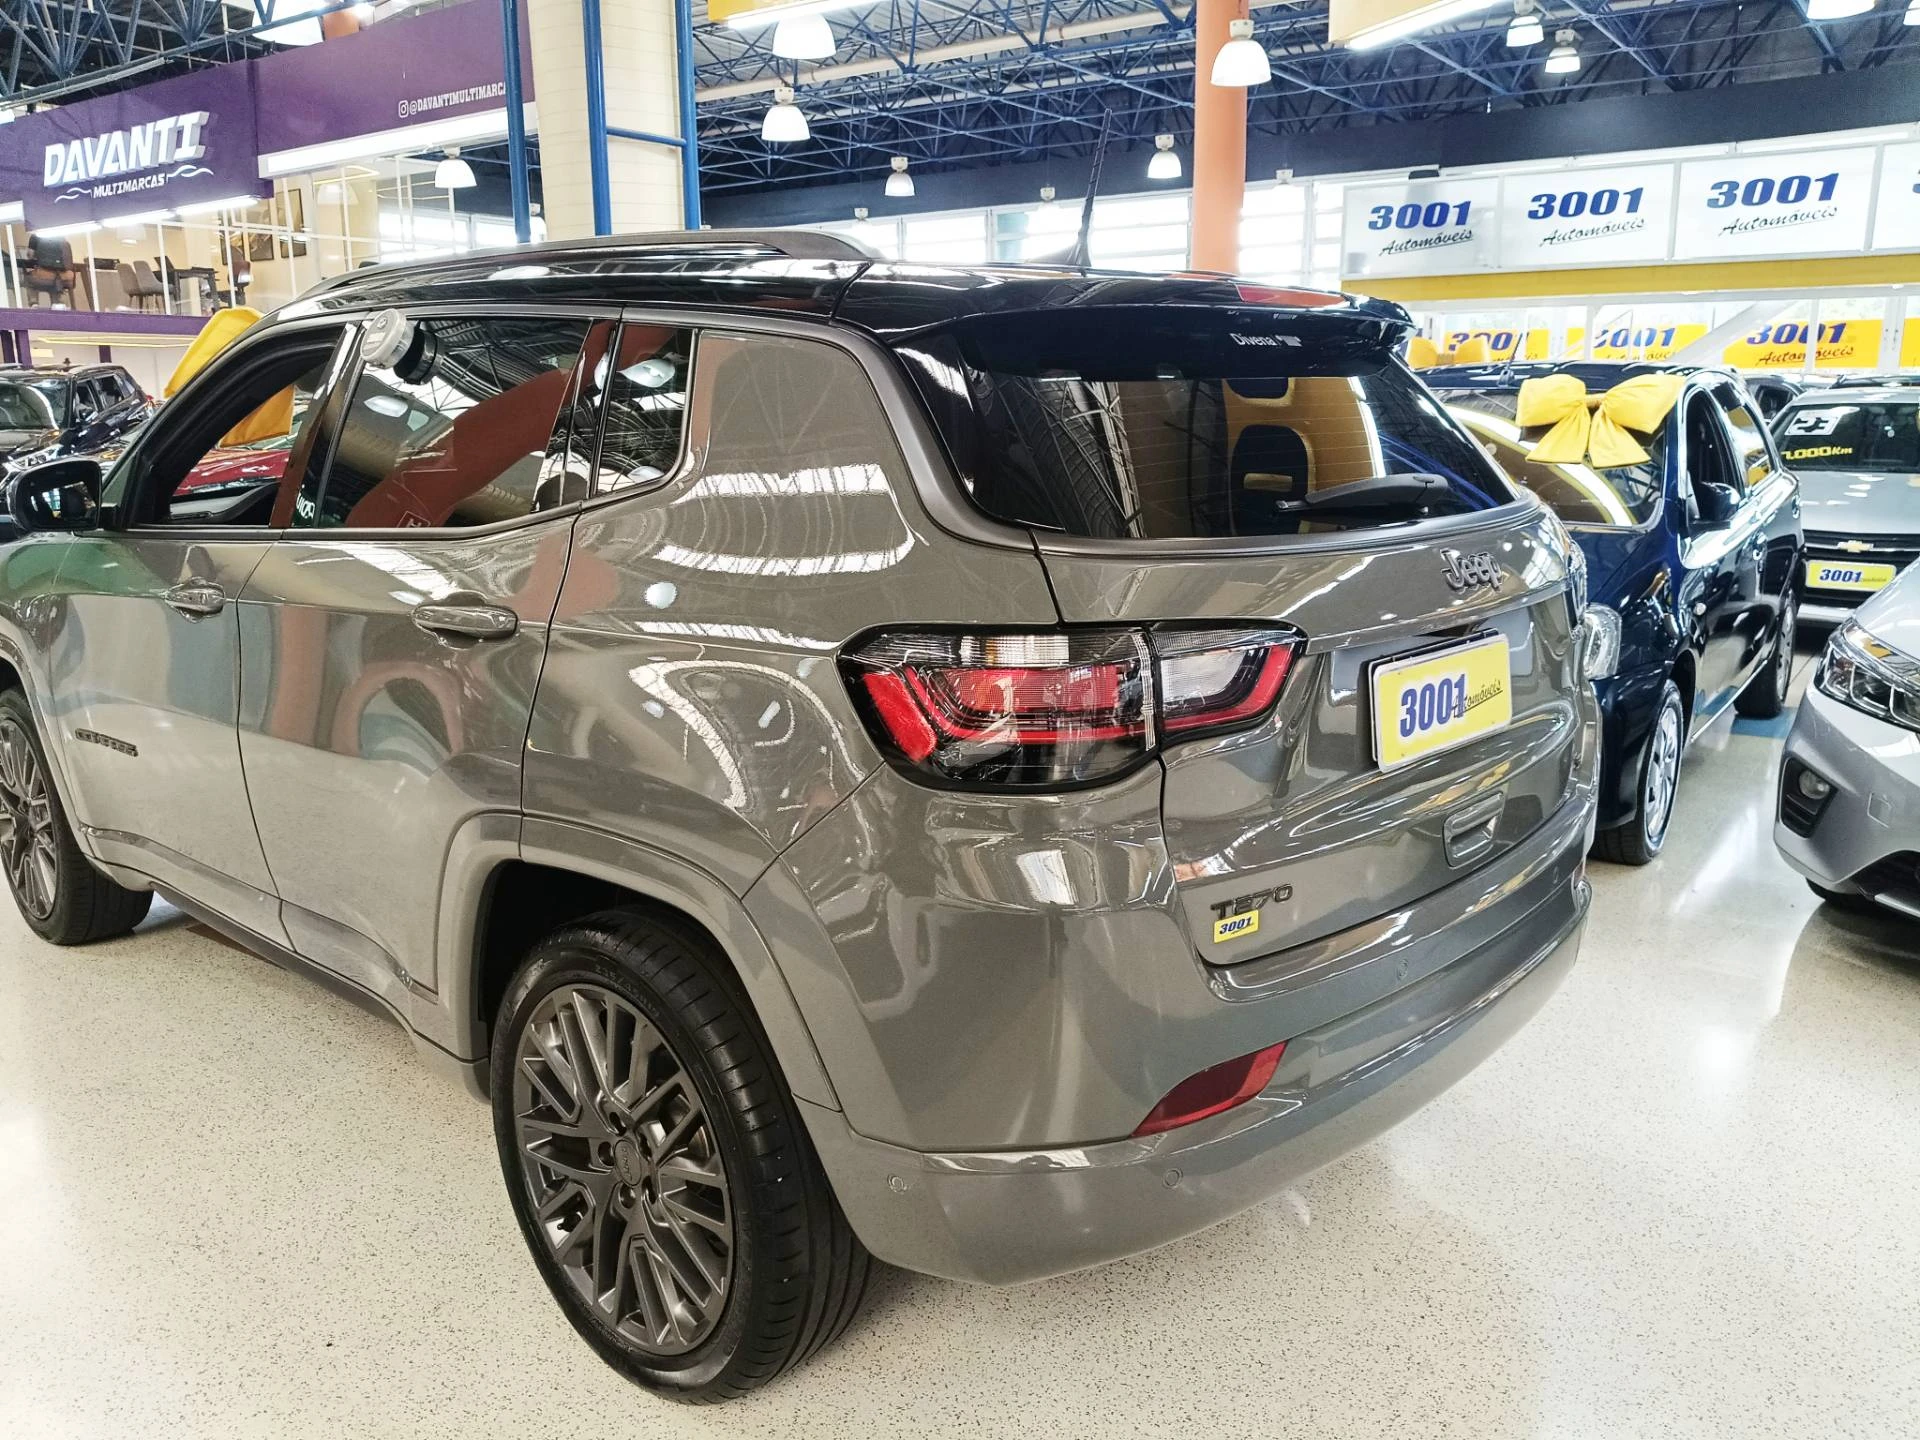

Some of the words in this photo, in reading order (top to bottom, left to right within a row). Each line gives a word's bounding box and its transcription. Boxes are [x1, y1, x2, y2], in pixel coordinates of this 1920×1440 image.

[43, 111, 210, 187] DAVANTI
[93, 173, 165, 198] MULTIMARCAS
[1706, 172, 1839, 209] 3001
[1368, 200, 1471, 230] 3001
[1527, 187, 1644, 220] 3001
[1539, 218, 1645, 248] Automóveis
[1718, 206, 1838, 236] Automóveis
[1379, 229, 1474, 256] Automóveis
[1746, 322, 1847, 345] 3001
[1440, 549, 1502, 591] Jeep
[1819, 568, 1862, 583] 3001
[1399, 673, 1466, 738] 3001
[1219, 916, 1253, 935] 3001
